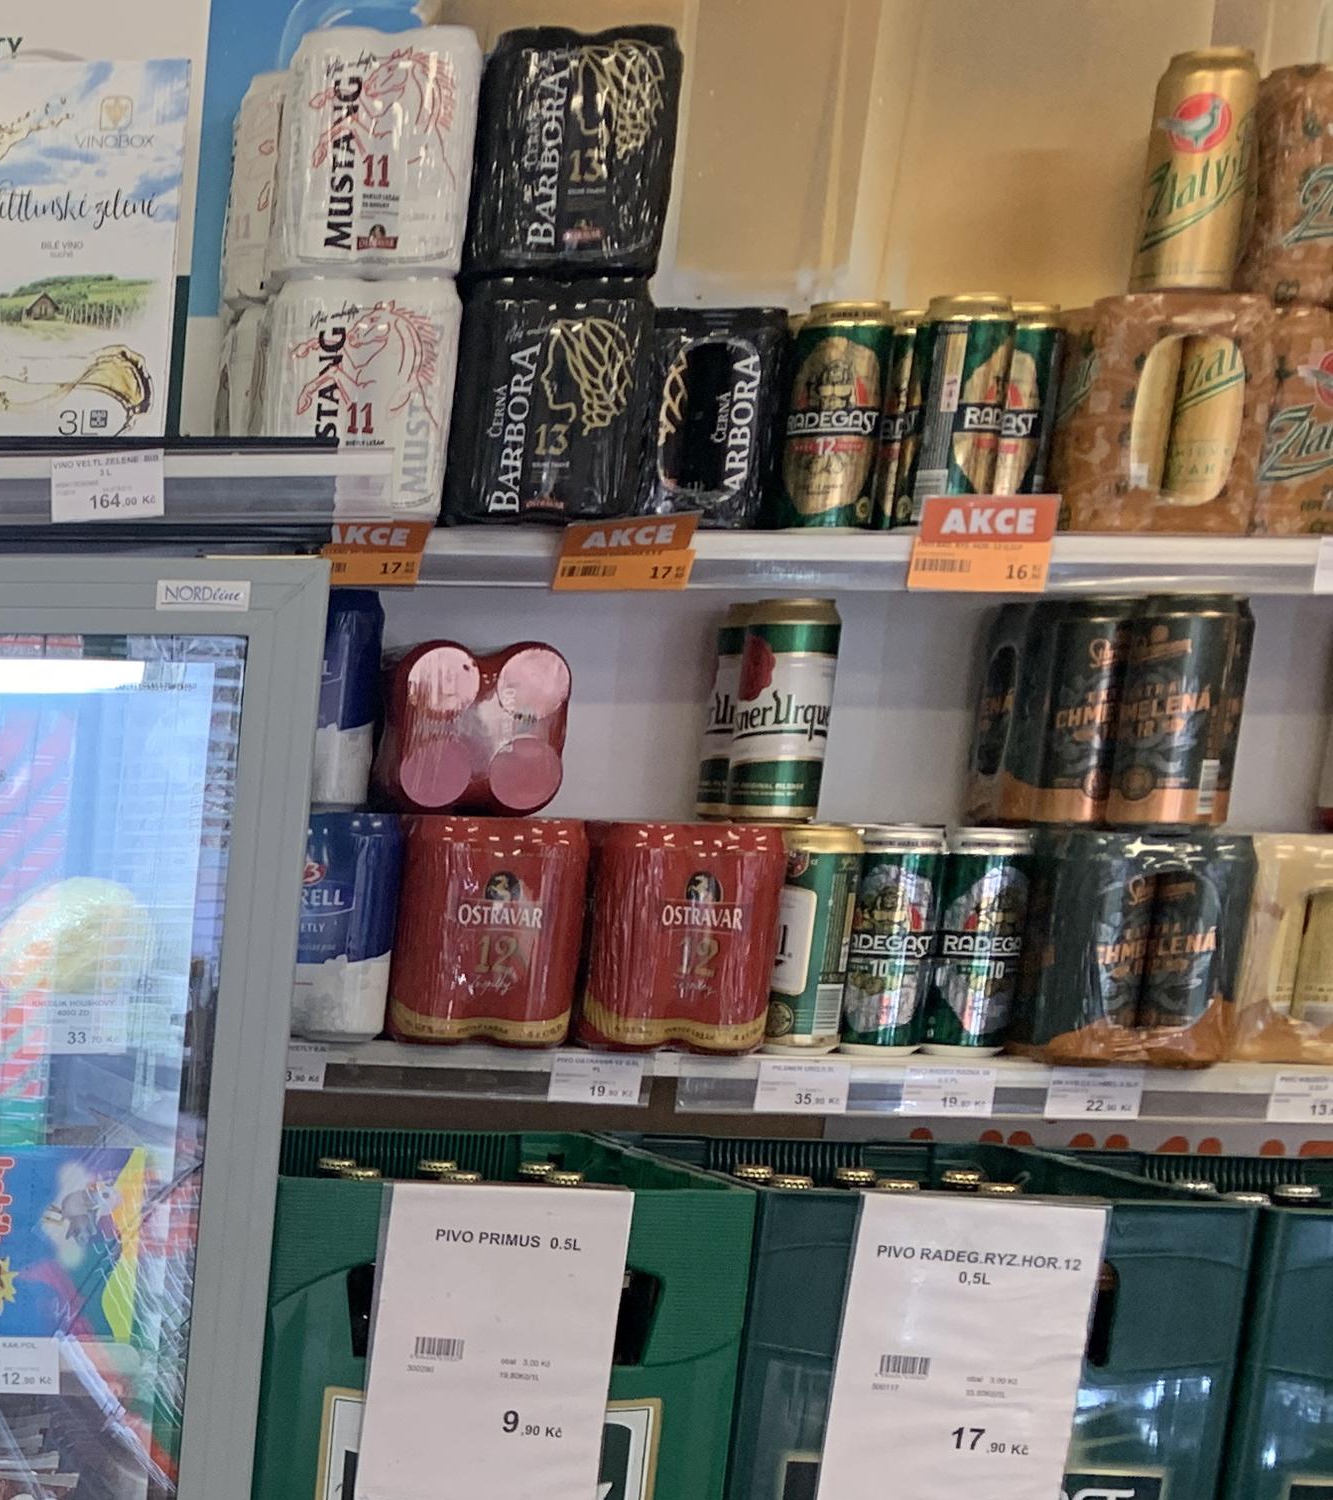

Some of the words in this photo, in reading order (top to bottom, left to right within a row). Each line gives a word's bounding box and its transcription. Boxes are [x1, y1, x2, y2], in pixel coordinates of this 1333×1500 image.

[75, 135, 154, 149] VINOBOX
[526, 67, 573, 247] BARBORA
[363, 154, 391, 188] 11
[347, 402, 374, 434] 11
[487, 384, 509, 439] ČERNÁ
[786, 409, 879, 434] RADEGAST
[487, 341, 543, 514] BARBORA
[535, 423, 570, 456] 13
[940, 508, 1036, 534] AKCE
[582, 524, 677, 549] AKCE
[379, 561, 401, 574] 17
[649, 565, 672, 580] 17
[1005, 564, 1028, 580] 16
[165, 584, 243, 602] NORDline
[458, 903, 542, 928] OSTRAVAR
[661, 904, 743, 928] OSTRAVAR
[477, 937, 519, 974] 12
[435, 1229, 475, 1244] PIVO
[478, 1232, 541, 1249] PRIMUS
[549, 1236, 582, 1252] 0.5L
[876, 1244, 916, 1260] PIVO
[545, 1425, 563, 1439] Kč
[1010, 1443, 1030, 1457] Kč
